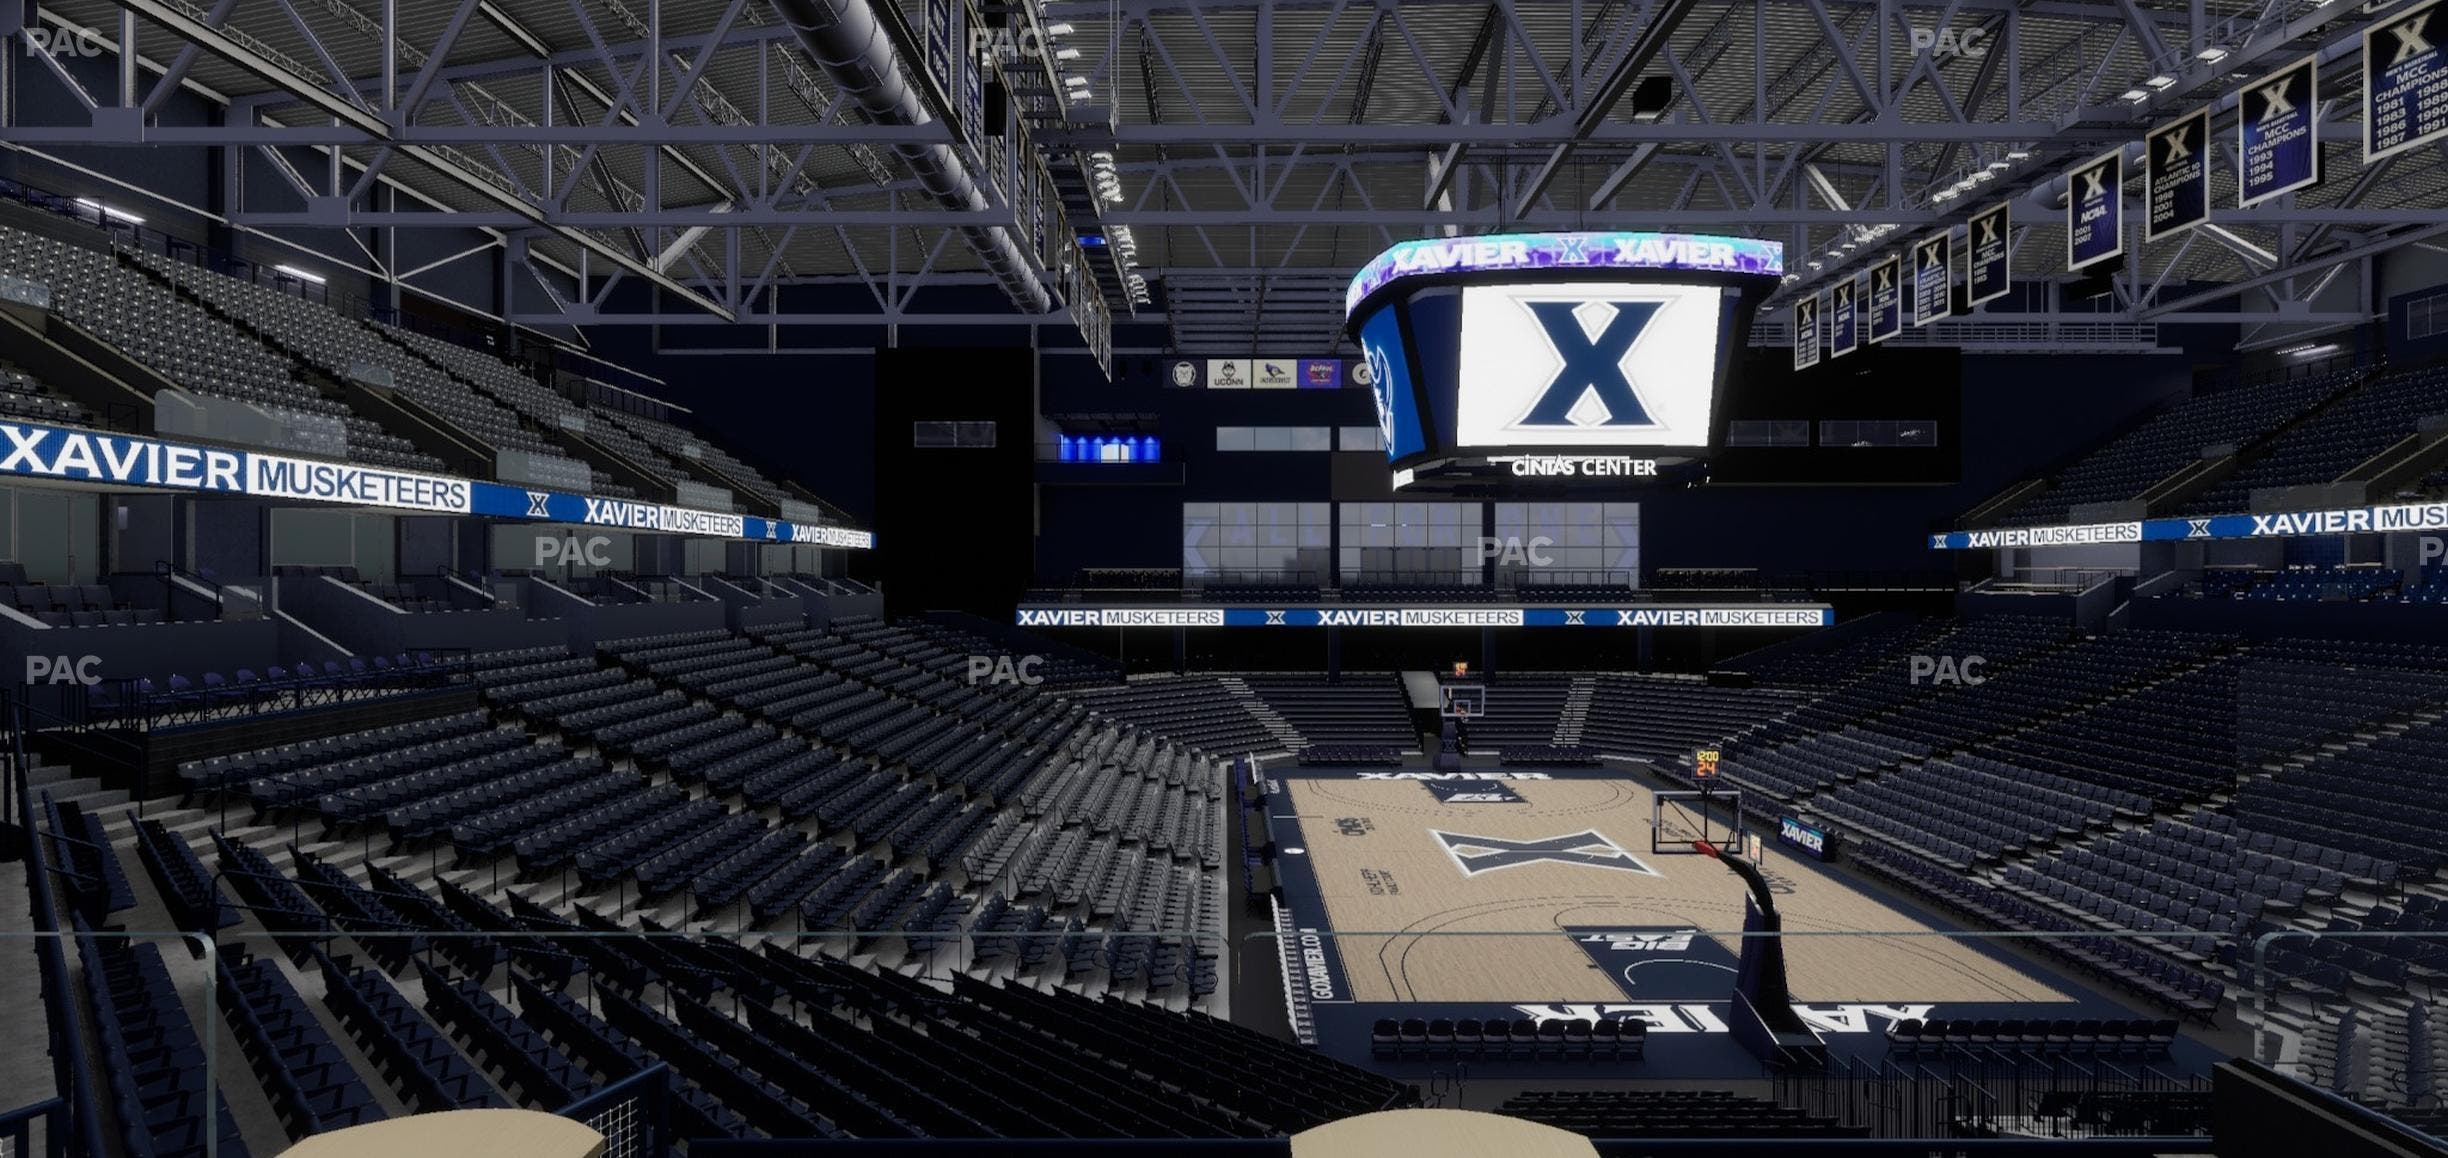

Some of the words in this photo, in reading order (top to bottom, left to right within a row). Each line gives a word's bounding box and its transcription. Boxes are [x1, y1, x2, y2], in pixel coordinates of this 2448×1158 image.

[2387, 8, 2437, 69] X
[2375, 66, 2448, 103] CHAMPIONS
[2396, 63, 2428, 84] MCC
[2258, 75, 2296, 125] X
[2377, 97, 2404, 115] 1981
[2417, 78, 2448, 99] 1988
[2377, 107, 2406, 127] 1983
[2417, 91, 2448, 111] 1989
[2264, 122, 2290, 140] MCC
[2376, 119, 2406, 138] 1986
[2417, 104, 2448, 123] 1990
[2377, 132, 2406, 150] 1987
[2418, 117, 2446, 135] 1991
[2163, 124, 2192, 166] X
[2248, 126, 2306, 155] CHAMPIONS
[2249, 150, 2273, 166] 1993
[2249, 160, 2273, 177] 1994
[2081, 163, 2108, 203] X
[2154, 169, 2201, 194] CHAMPIONS
[2249, 171, 2273, 187] 1995
[1391, 240, 1530, 275] XAVIER
[1558, 237, 1589, 263] X
[1613, 238, 1738, 267] XAVIER
[1504, 296, 1679, 430] X
[0, 425, 242, 491] XAVIER
[257, 458, 466, 509] MUSKETEERS
[584, 497, 659, 529] XAVIER
[663, 509, 741, 535] MUSKETEERS
[791, 523, 826, 543] XAVIER
[1582, 459, 1657, 476] CENTER
[1968, 530, 2028, 548] XAVIER
[2034, 524, 2138, 544] MUSKETEERS
[2251, 509, 2370, 536] XAVIER
[2382, 505, 2448, 527] MUS
[1018, 610, 1099, 626] XAVIER
[1106, 611, 1220, 625] MUSKETEERS
[1317, 610, 1399, 625] XAVIER
[1405, 611, 1519, 624] MUSKETEERS
[1617, 610, 1699, 625] XAVIER
[1705, 611, 1819, 624] MUSKETEERS
[1697, 751, 1719, 761] 12:00
[1697, 762, 1715, 776] 24
[1781, 822, 1822, 852] XAVIER
